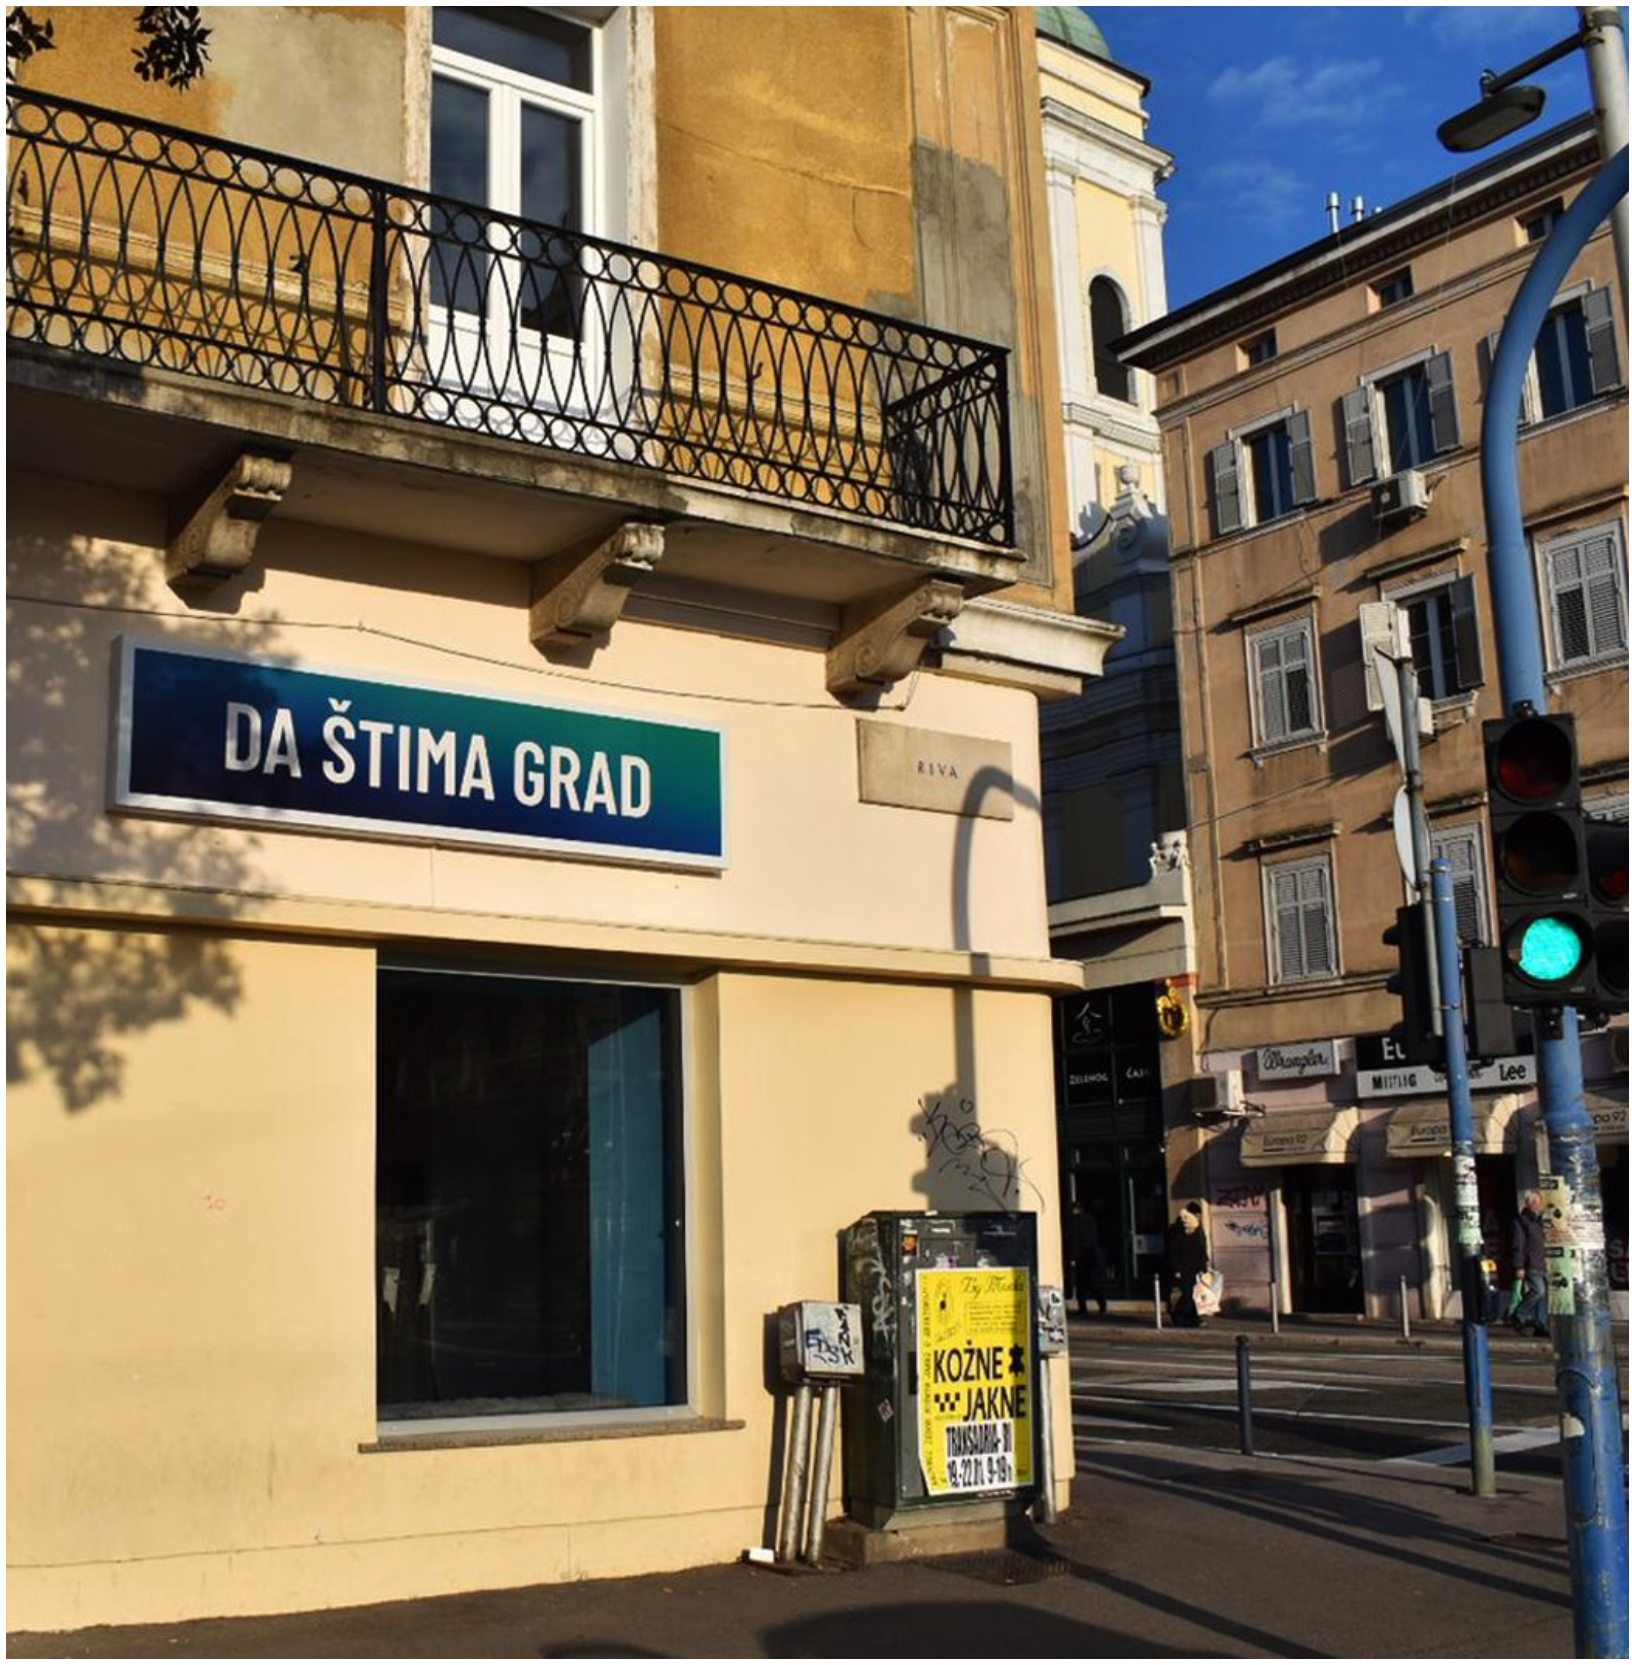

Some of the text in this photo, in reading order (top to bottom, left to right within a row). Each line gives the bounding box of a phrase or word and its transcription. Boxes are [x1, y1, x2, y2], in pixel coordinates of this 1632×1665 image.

[225, 698, 652, 819] DA ŠTIMA GRAD
[917, 760, 959, 779] RIVA
[1499, 1063, 1527, 1082] Lee
[963, 1384, 1027, 1421] JAKNE
